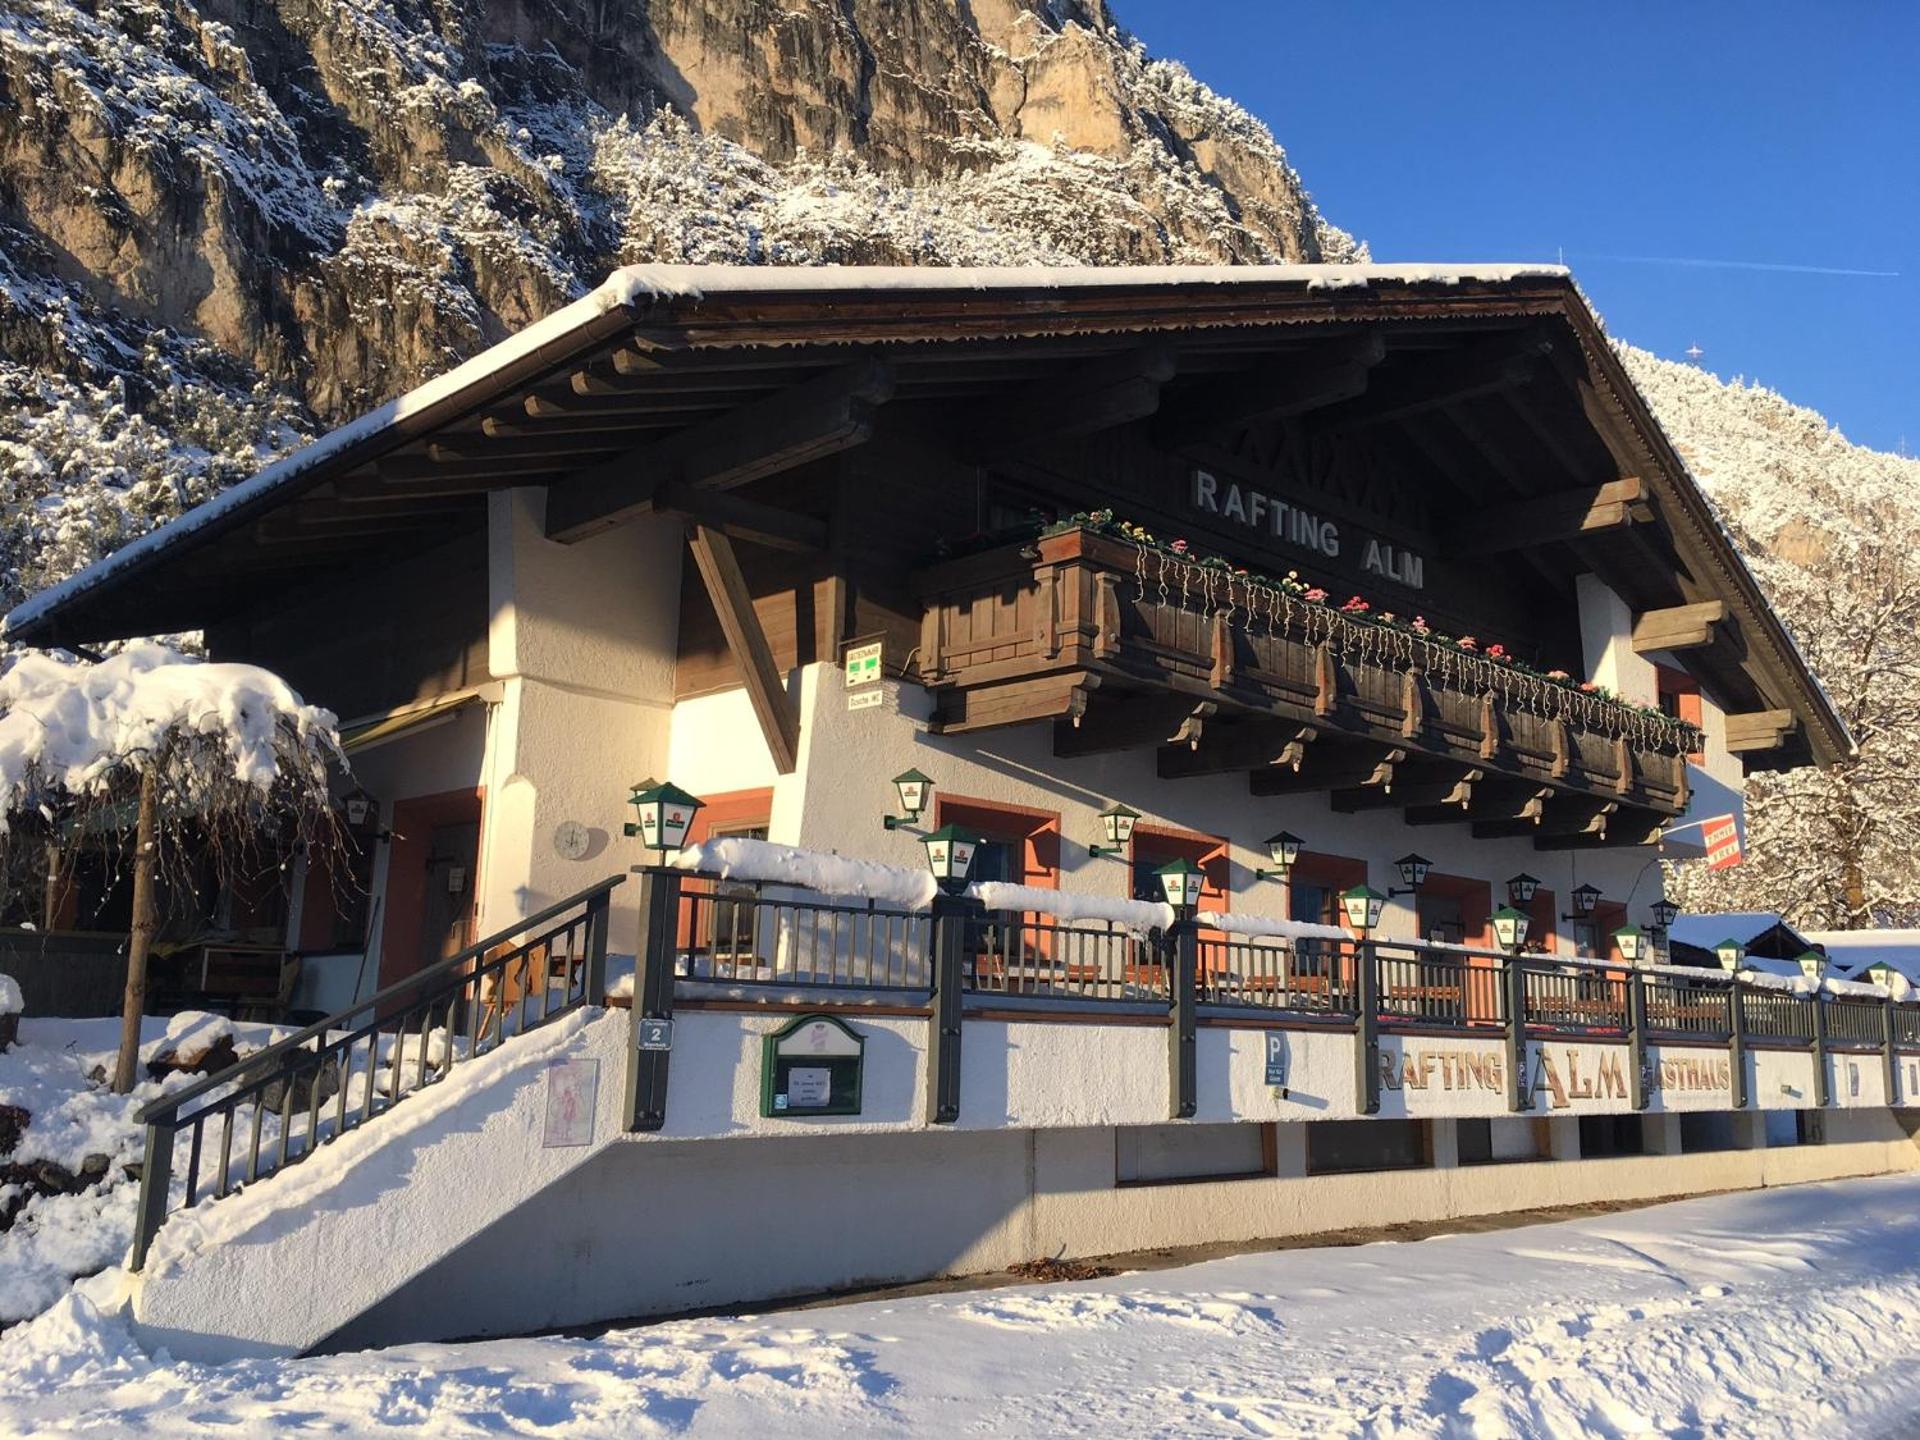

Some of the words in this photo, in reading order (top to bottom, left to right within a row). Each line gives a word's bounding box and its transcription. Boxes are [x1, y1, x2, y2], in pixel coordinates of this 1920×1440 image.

[1195, 470, 1339, 557] RAFTING
[1363, 539, 1423, 589] ALM
[651, 1028, 661, 1041] 2
[1269, 1036, 1280, 1062] P
[1377, 1050, 1502, 1095] RAFTING
[1522, 1048, 1628, 1109] ALM
